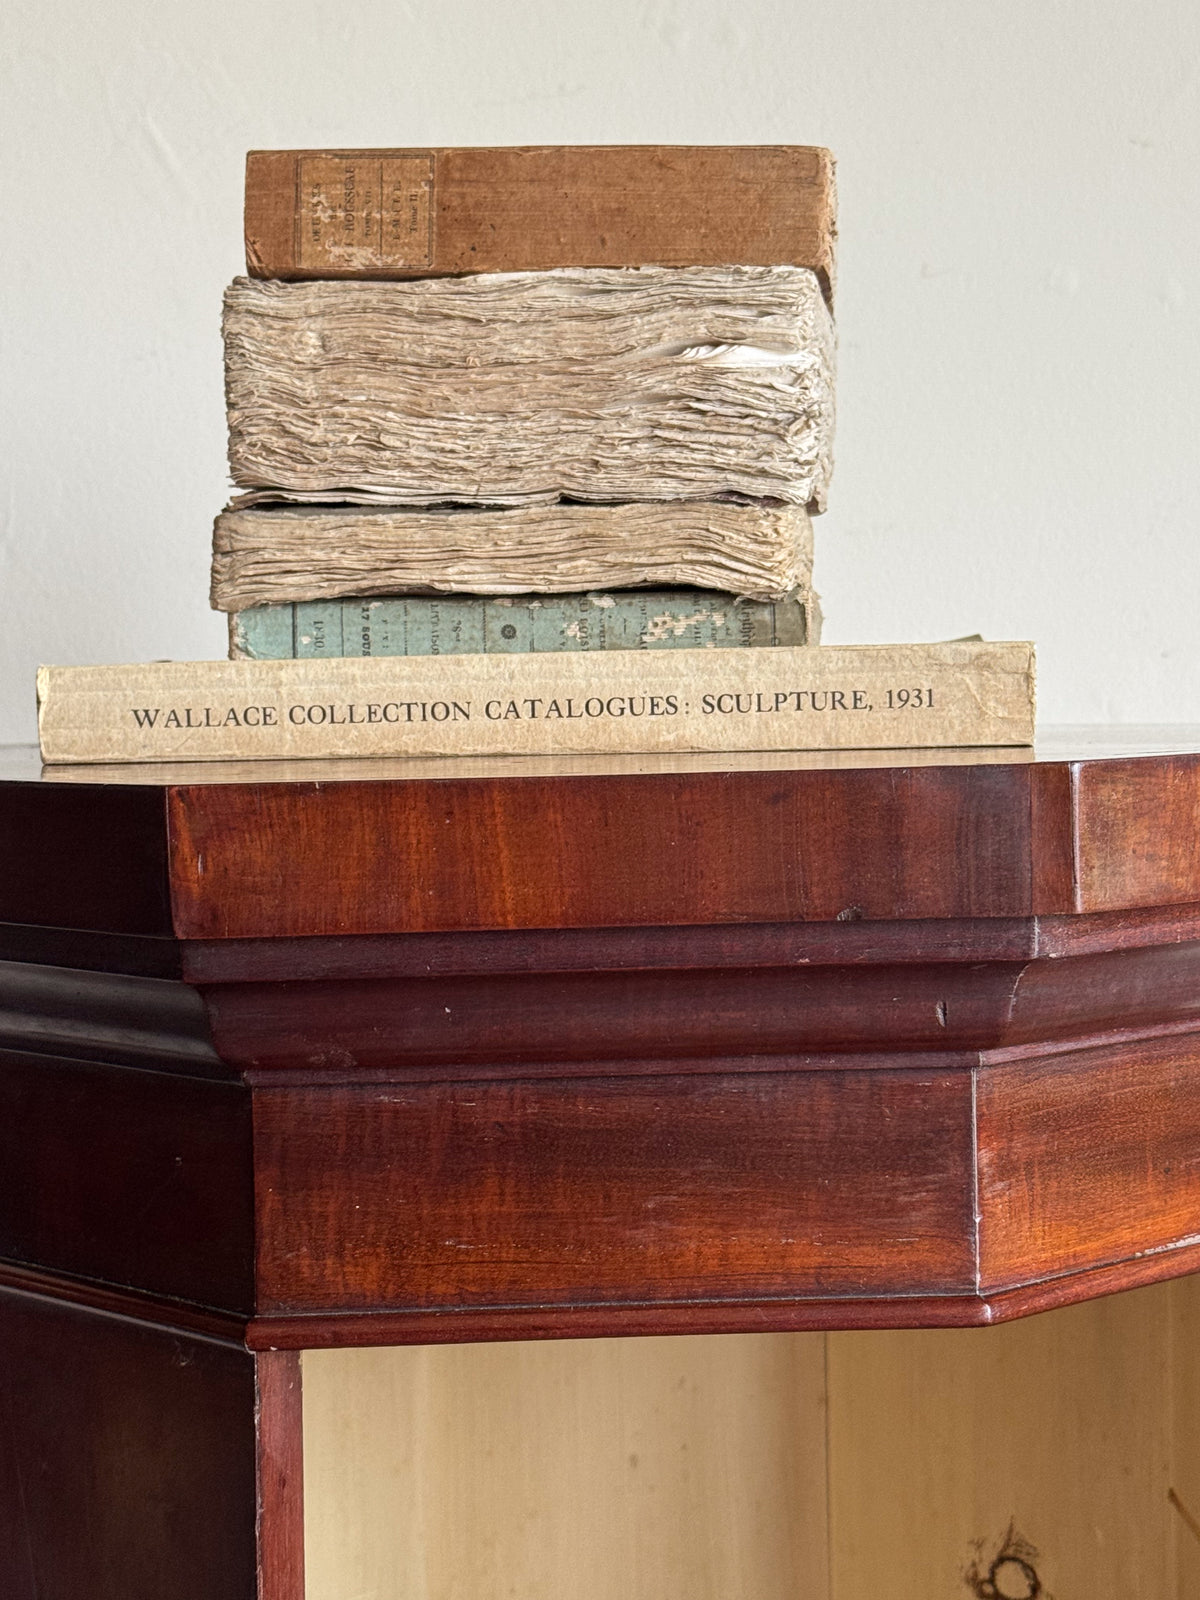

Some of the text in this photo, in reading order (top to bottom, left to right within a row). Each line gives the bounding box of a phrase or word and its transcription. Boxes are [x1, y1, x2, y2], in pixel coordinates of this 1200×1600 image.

[362, 607, 372, 657] 17 SOUS
[131, 706, 278, 729] WALLACE
[288, 701, 472, 726] COLLECTION
[701, 690, 874, 715] SCULPTURE,
[884, 688, 935, 710] 1931
